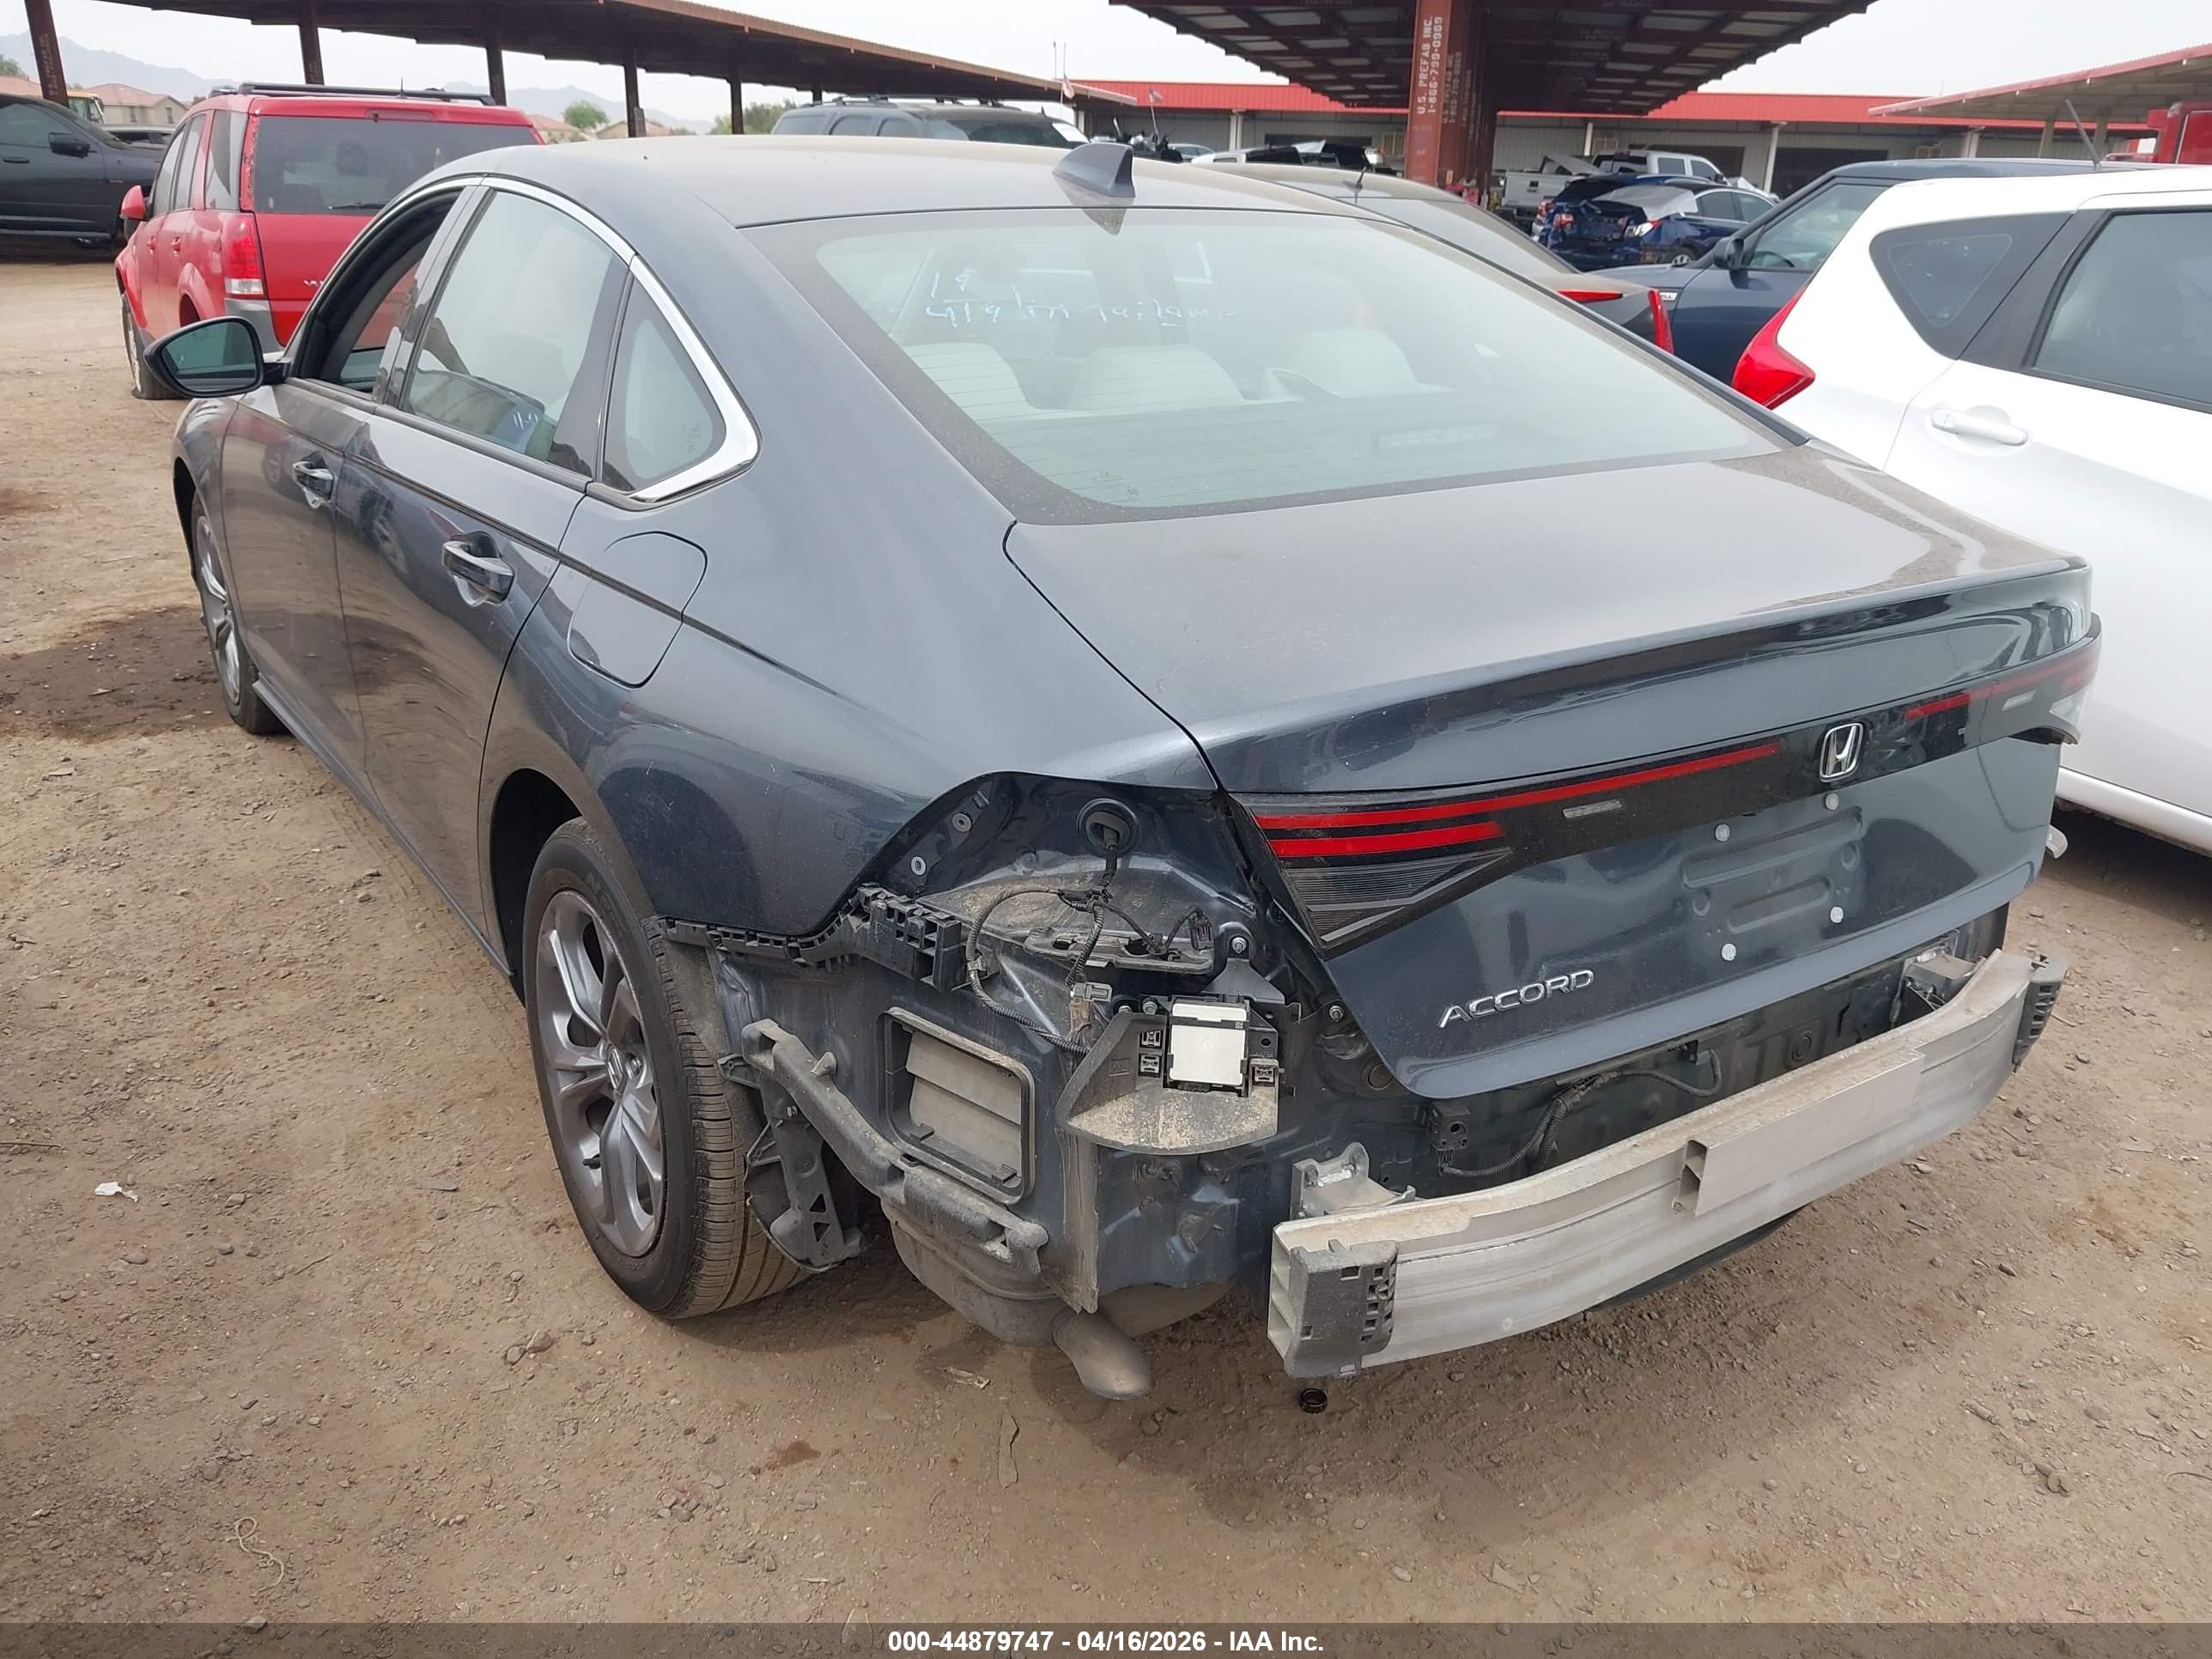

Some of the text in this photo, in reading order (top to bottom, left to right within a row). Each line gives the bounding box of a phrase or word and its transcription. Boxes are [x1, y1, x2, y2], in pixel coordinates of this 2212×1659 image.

[1422, 16, 1432, 38] INC.
[1419, 44, 1431, 87] PREFAB
[1416, 93, 1427, 114] U.S.
[1437, 969, 1595, 1029] ACCORD
